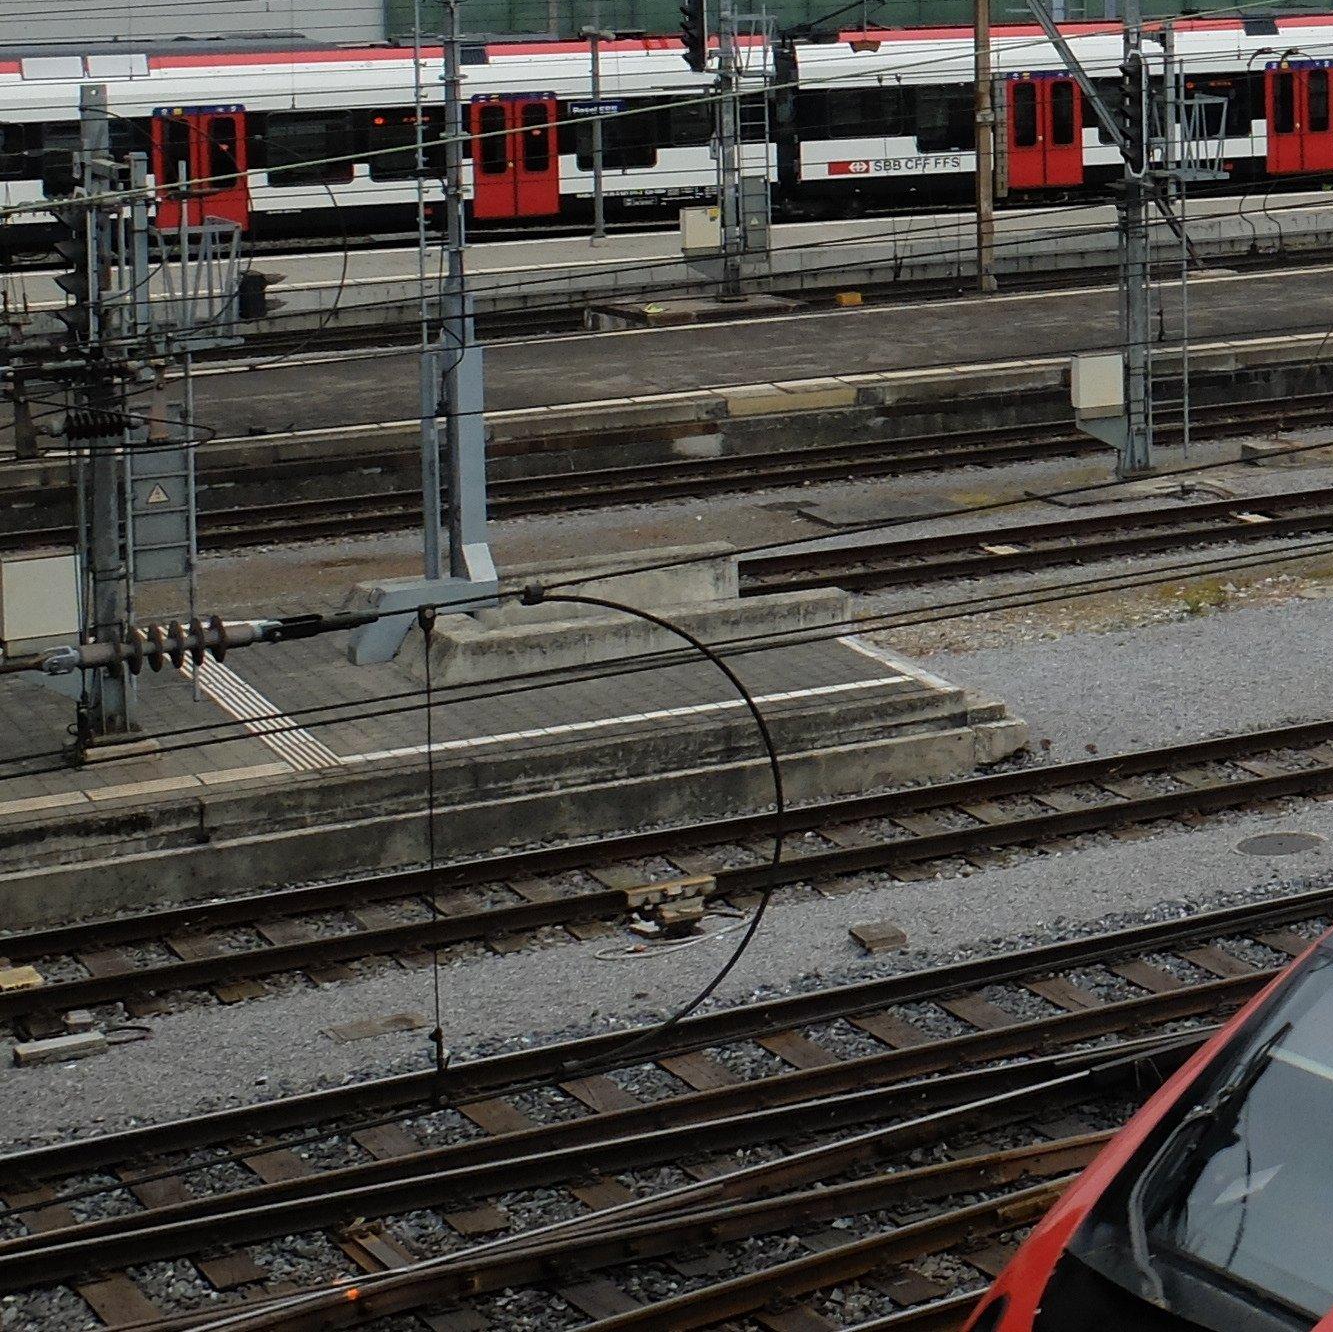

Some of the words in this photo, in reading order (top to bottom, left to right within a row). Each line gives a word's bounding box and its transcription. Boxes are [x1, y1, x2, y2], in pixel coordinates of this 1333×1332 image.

[874, 160, 901, 171] SBB
[905, 158, 930, 170] CFF
[934, 157, 960, 168] FFS
